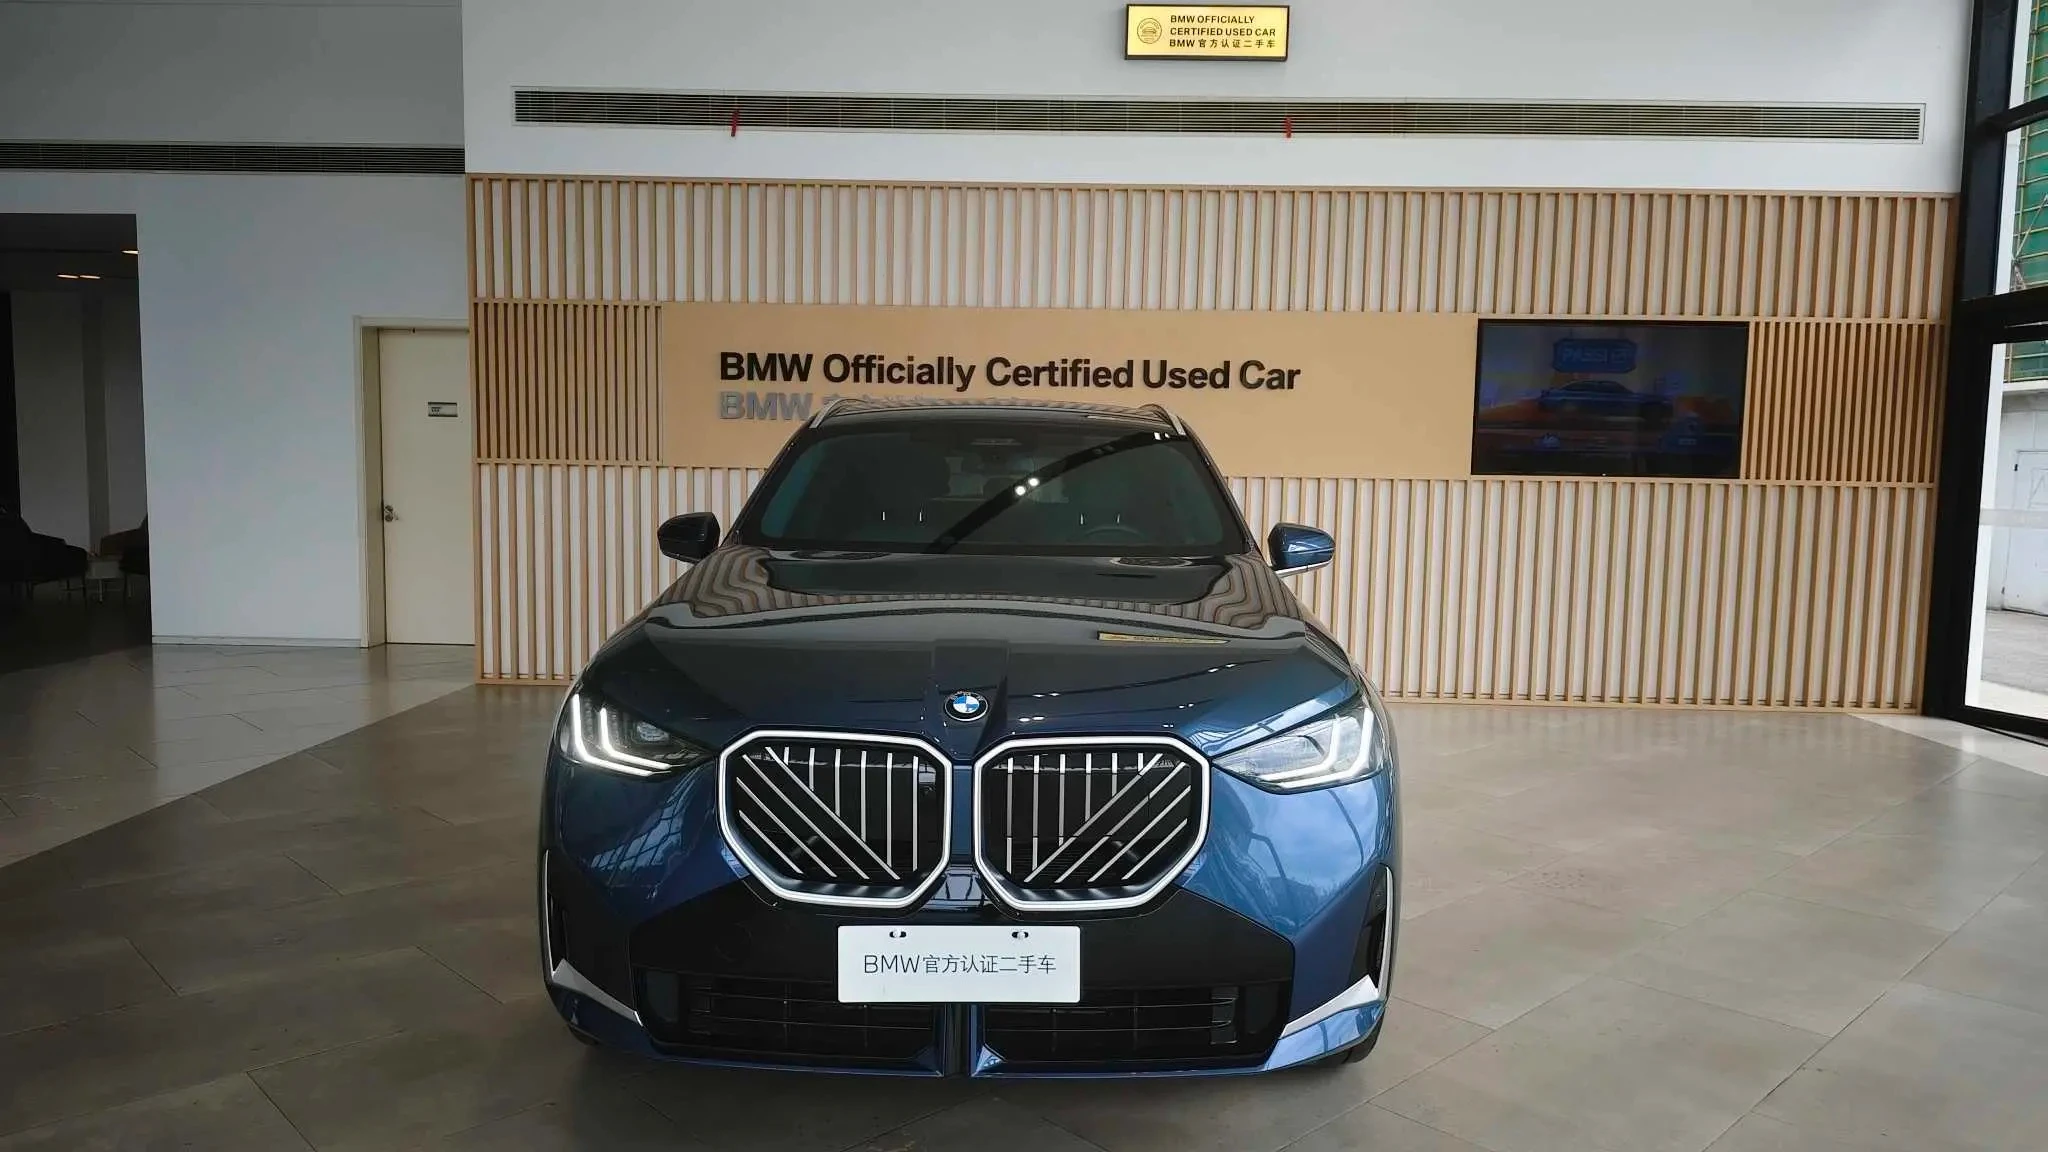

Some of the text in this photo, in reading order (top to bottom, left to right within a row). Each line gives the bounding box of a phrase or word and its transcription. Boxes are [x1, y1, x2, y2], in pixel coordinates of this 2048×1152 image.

[1170, 15, 1255, 24] BMW OFFICIALLY
[1170, 27, 1276, 37] CERTIFIED USED CAR
[1169, 38, 1276, 48] BMW 官方认证二手车
[720, 352, 1301, 392] BMW Officially Certified Used Car
[719, 391, 814, 421] BMW
[864, 954, 1057, 975] BMW官方认证二手车
